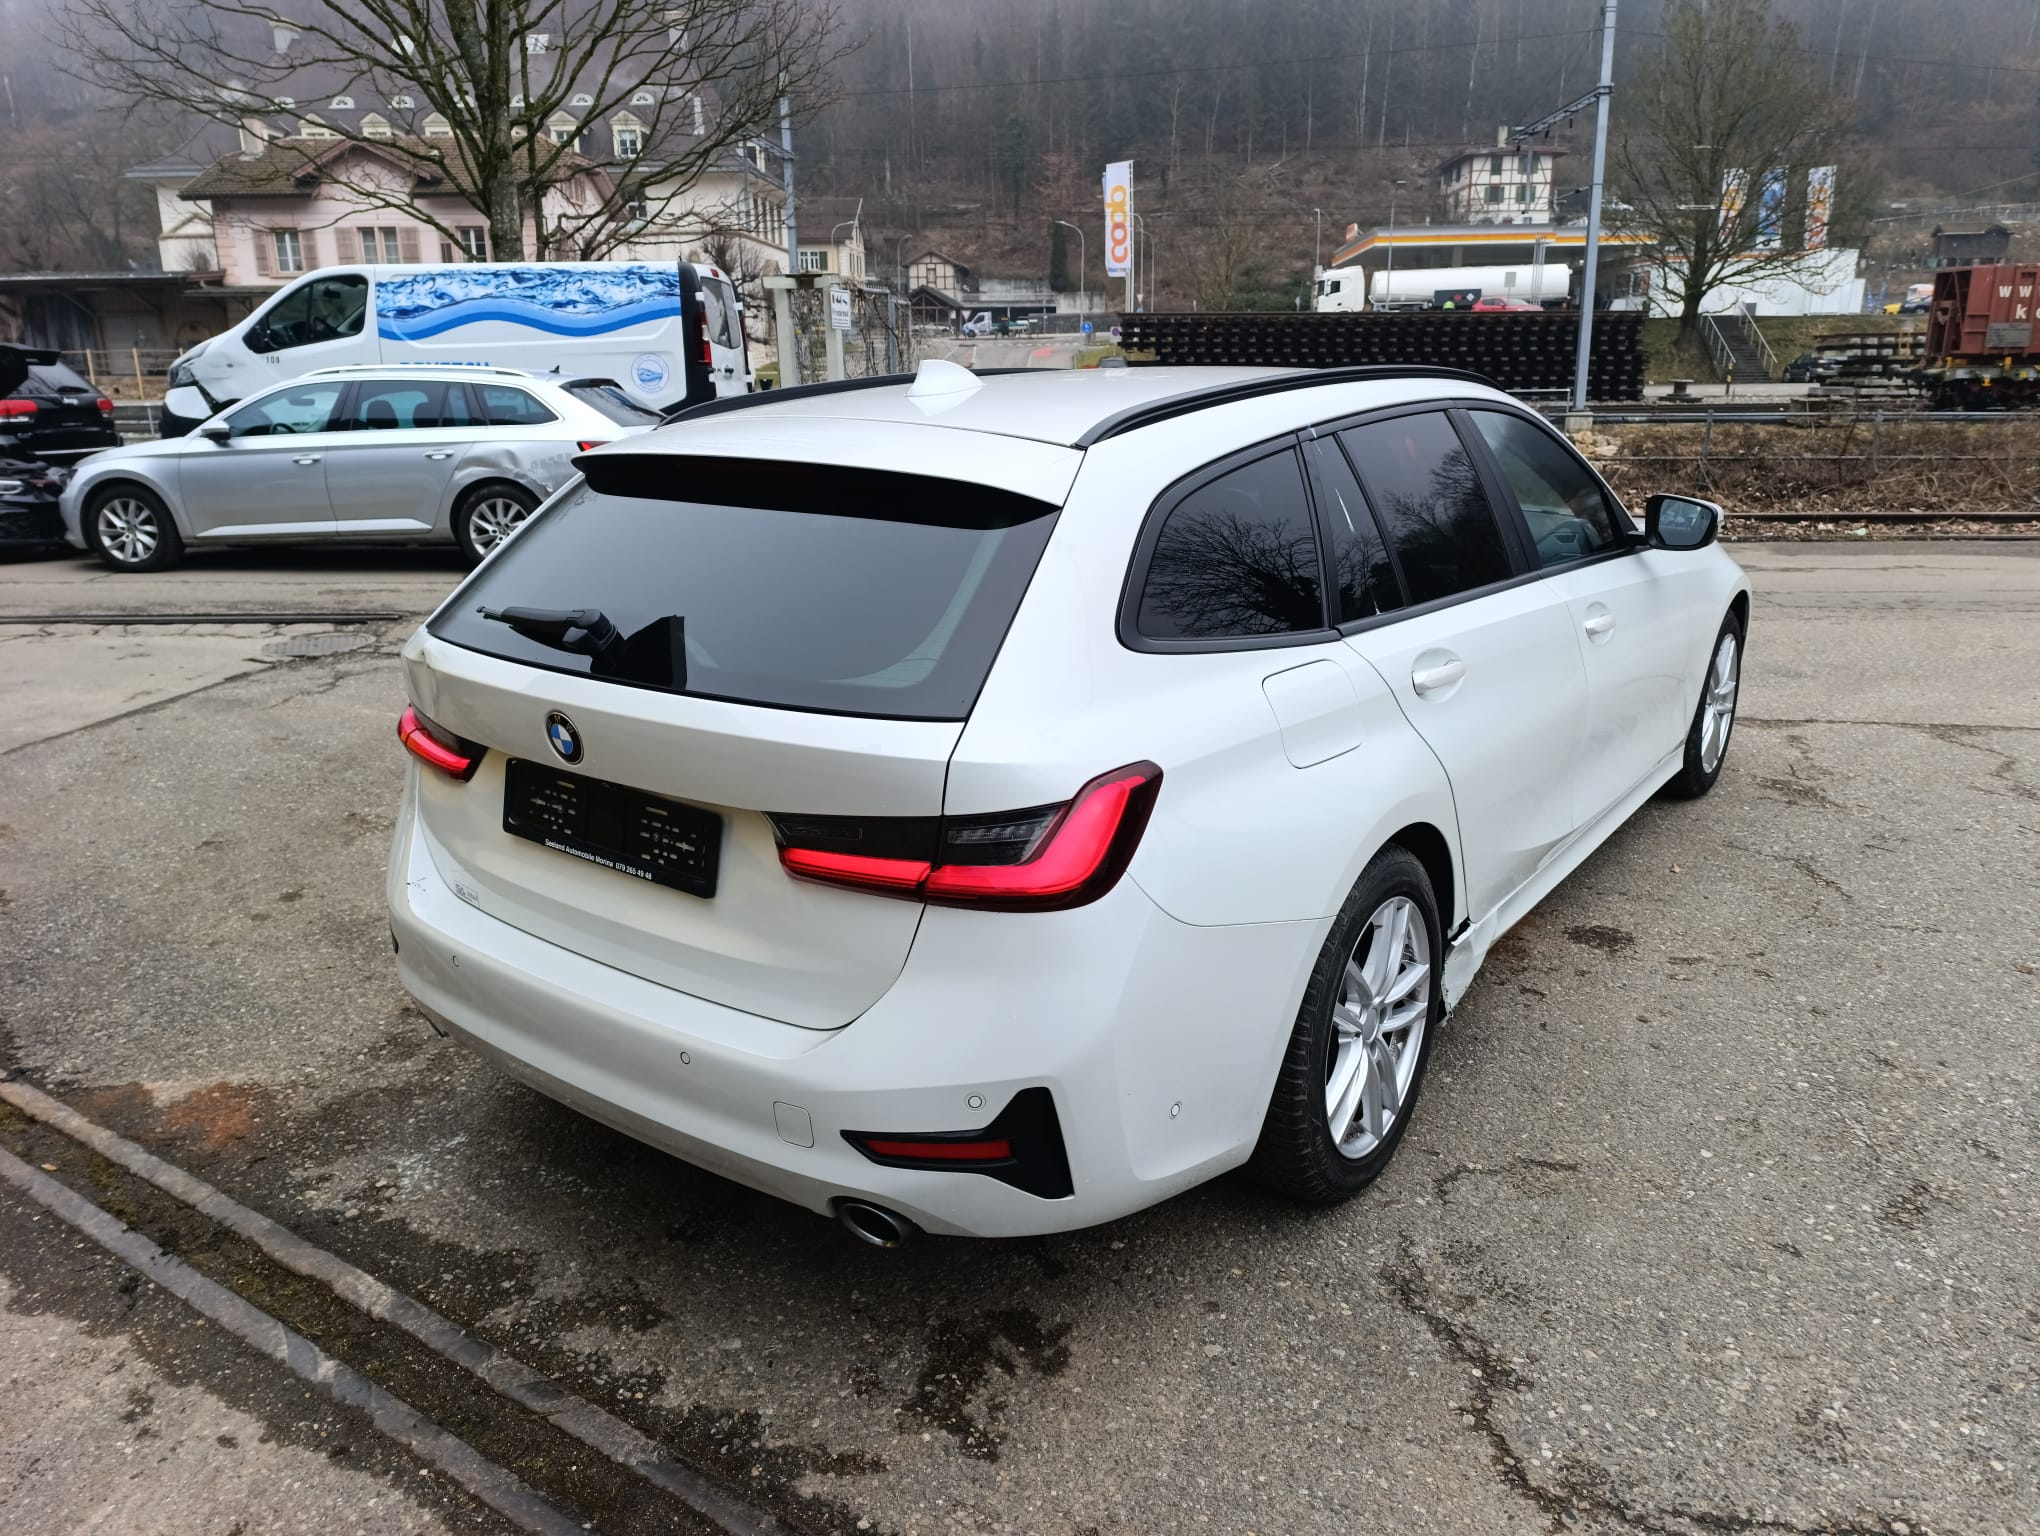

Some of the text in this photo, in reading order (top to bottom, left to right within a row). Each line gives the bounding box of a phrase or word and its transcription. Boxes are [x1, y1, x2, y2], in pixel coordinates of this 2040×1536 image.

[1105, 185, 1128, 263] coop
[1999, 285, 2040, 298] ww
[565, 846, 595, 861] Automobile
[615, 862, 626, 871] 079
